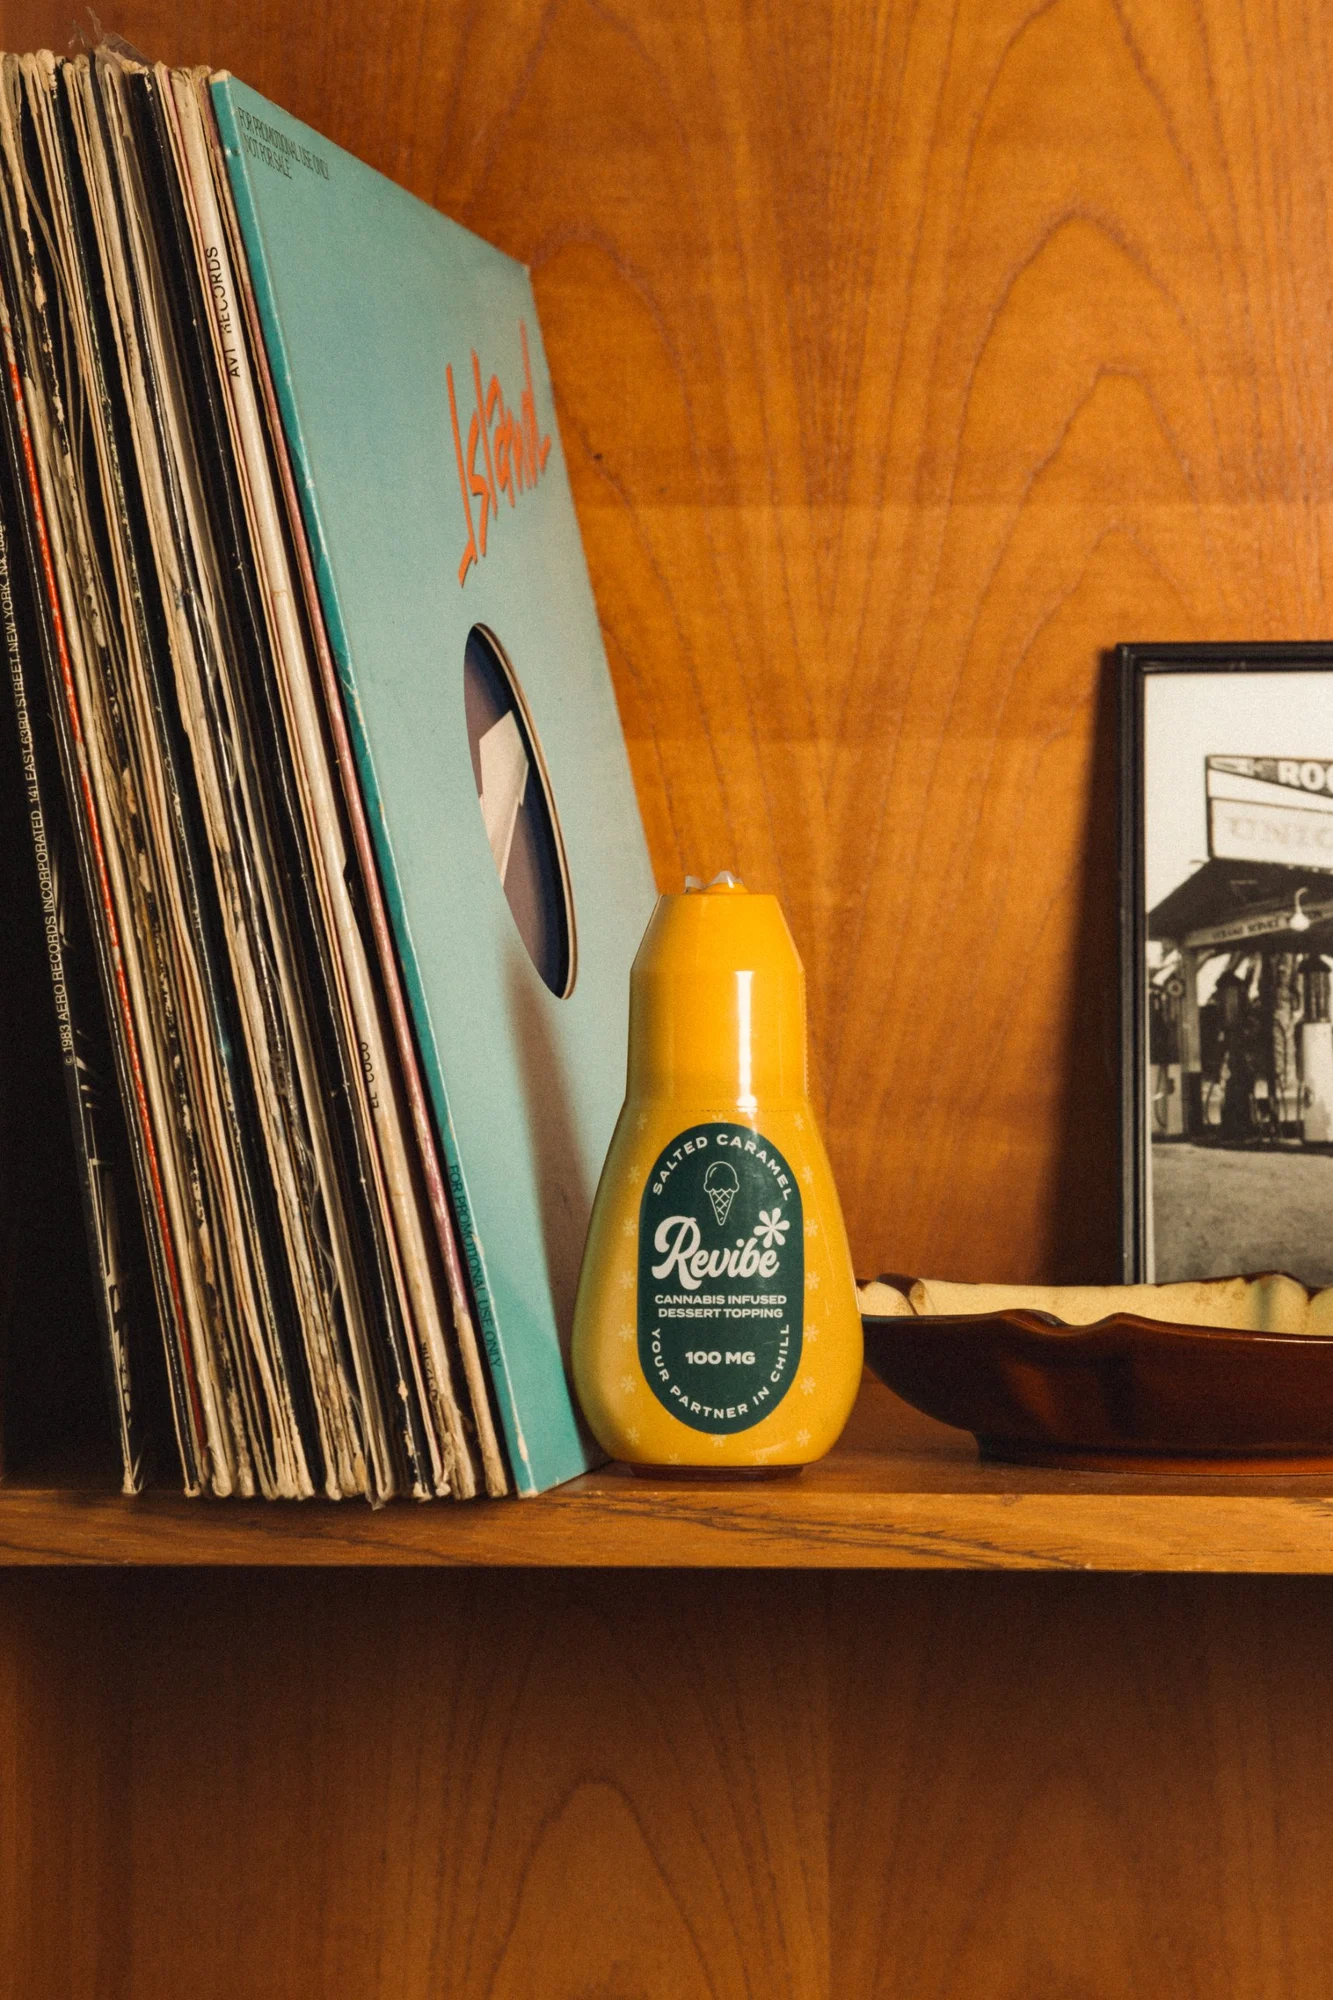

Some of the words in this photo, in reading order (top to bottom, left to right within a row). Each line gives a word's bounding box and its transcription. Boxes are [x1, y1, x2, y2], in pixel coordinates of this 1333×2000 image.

[238, 106, 253, 133] FOR
[252, 115, 301, 163] PROMOTIONAL
[298, 145, 314, 171] USE
[243, 132, 259, 159] NOT
[258, 142, 275, 170] FOR
[272, 151, 292, 179] SALE
[206, 246, 232, 334] RECORDS
[445, 316, 552, 588] Island
[4, 621, 18, 652] NEW
[17, 709, 33, 744] 63RD
[22, 746, 37, 785] EAST
[29, 785, 39, 803] 141
[30, 810, 57, 914] INCORPORATED
[45, 919, 65, 982] RECORDS
[53, 984, 70, 1022] AERO
[58, 1024, 73, 1052] 1983
[449, 1165, 463, 1192] FOR
[653, 1136, 708, 1196] SALTED
[716, 1133, 793, 1202] CARAMEL
[454, 1195, 487, 1292] PROMOTIONAL
[651, 1215, 780, 1290] Revibe
[478, 1299, 493, 1328] USE
[654, 1294, 725, 1306] CANNABIS
[727, 1294, 787, 1306] INFUSED
[658, 1308, 723, 1319] DESSERT
[723, 1308, 784, 1319] TOPPING
[484, 1331, 502, 1367] ONLY
[685, 1351, 722, 1366] 100
[725, 1351, 756, 1366] MG
[651, 1327, 670, 1383] YOUR
[669, 1384, 749, 1420] PARTNER
[752, 1385, 770, 1406] IN
[770, 1324, 790, 1383] CHILL
